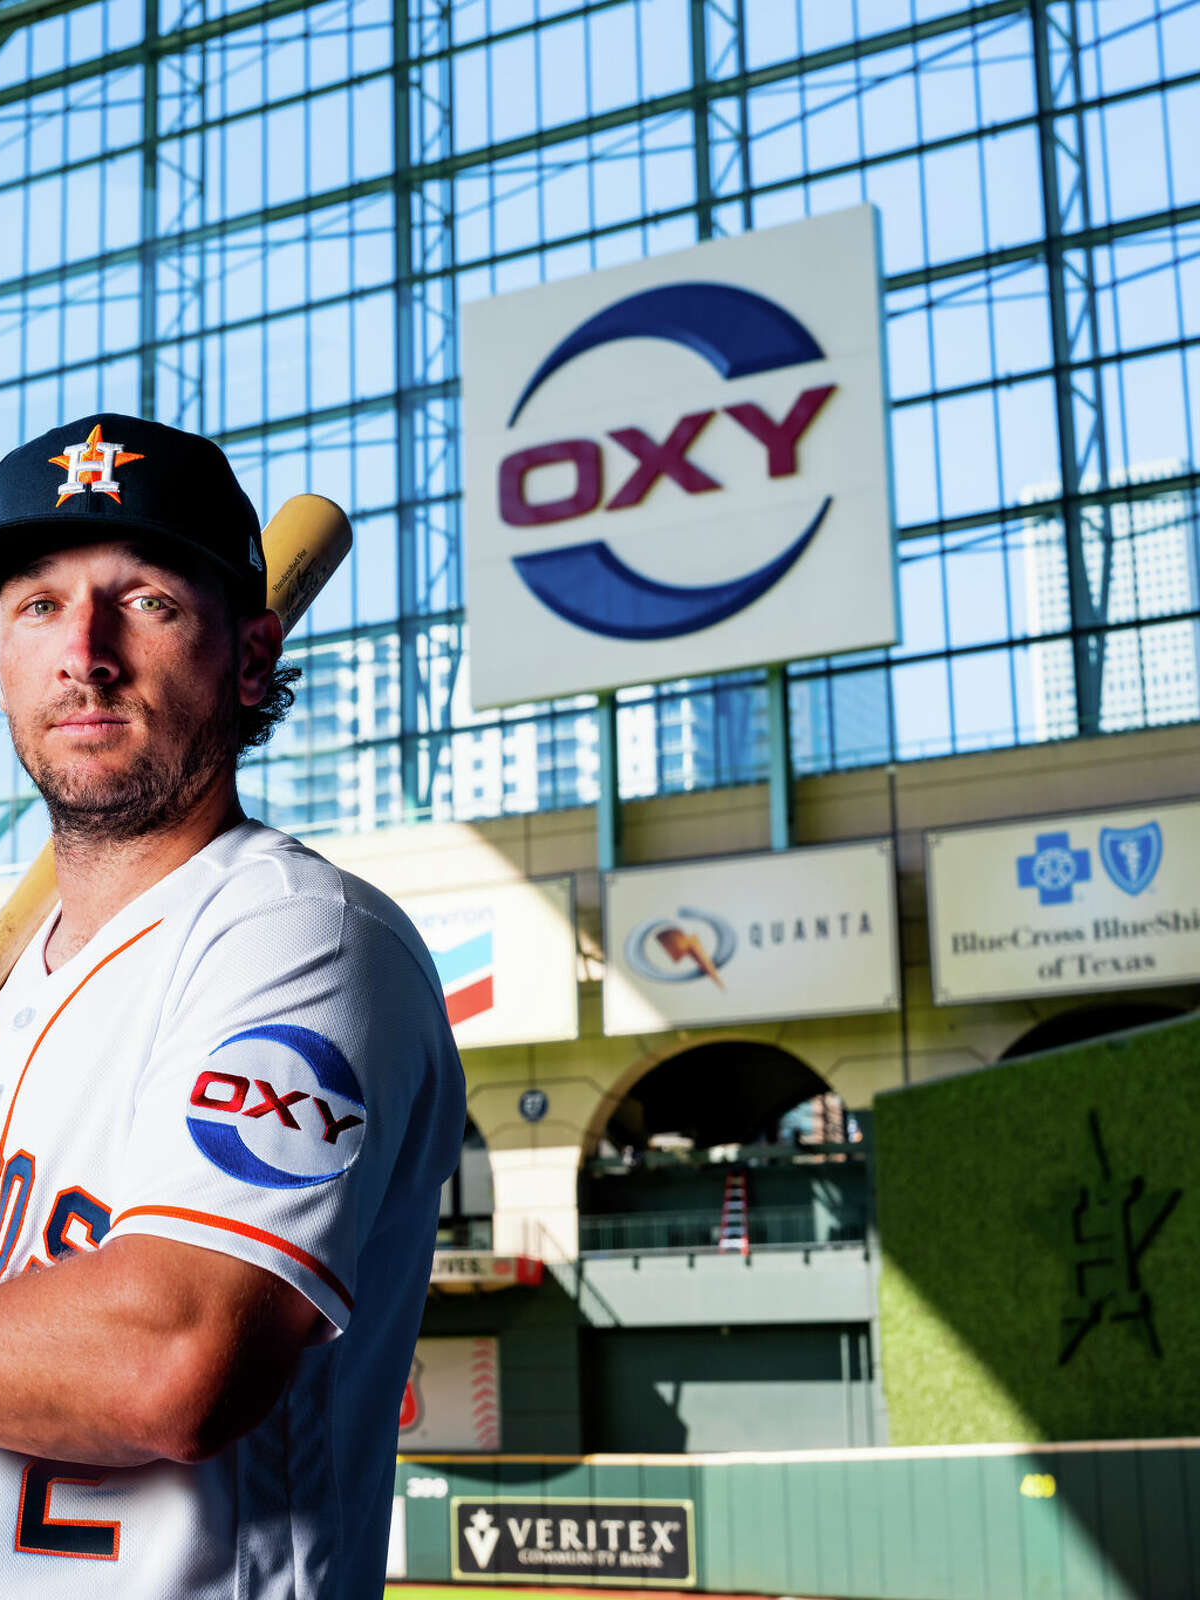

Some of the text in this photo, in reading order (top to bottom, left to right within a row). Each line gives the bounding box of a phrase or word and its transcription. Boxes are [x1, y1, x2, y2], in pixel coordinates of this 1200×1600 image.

[57, 441, 125, 496] H
[499, 382, 839, 527] OXY
[748, 910, 872, 948] QUANTA
[951, 908, 1200, 956] BlueCross BlueShi
[1037, 951, 1157, 981] of Texas
[190, 1070, 364, 1144] OXY
[507, 1517, 676, 1553] VERITEX
